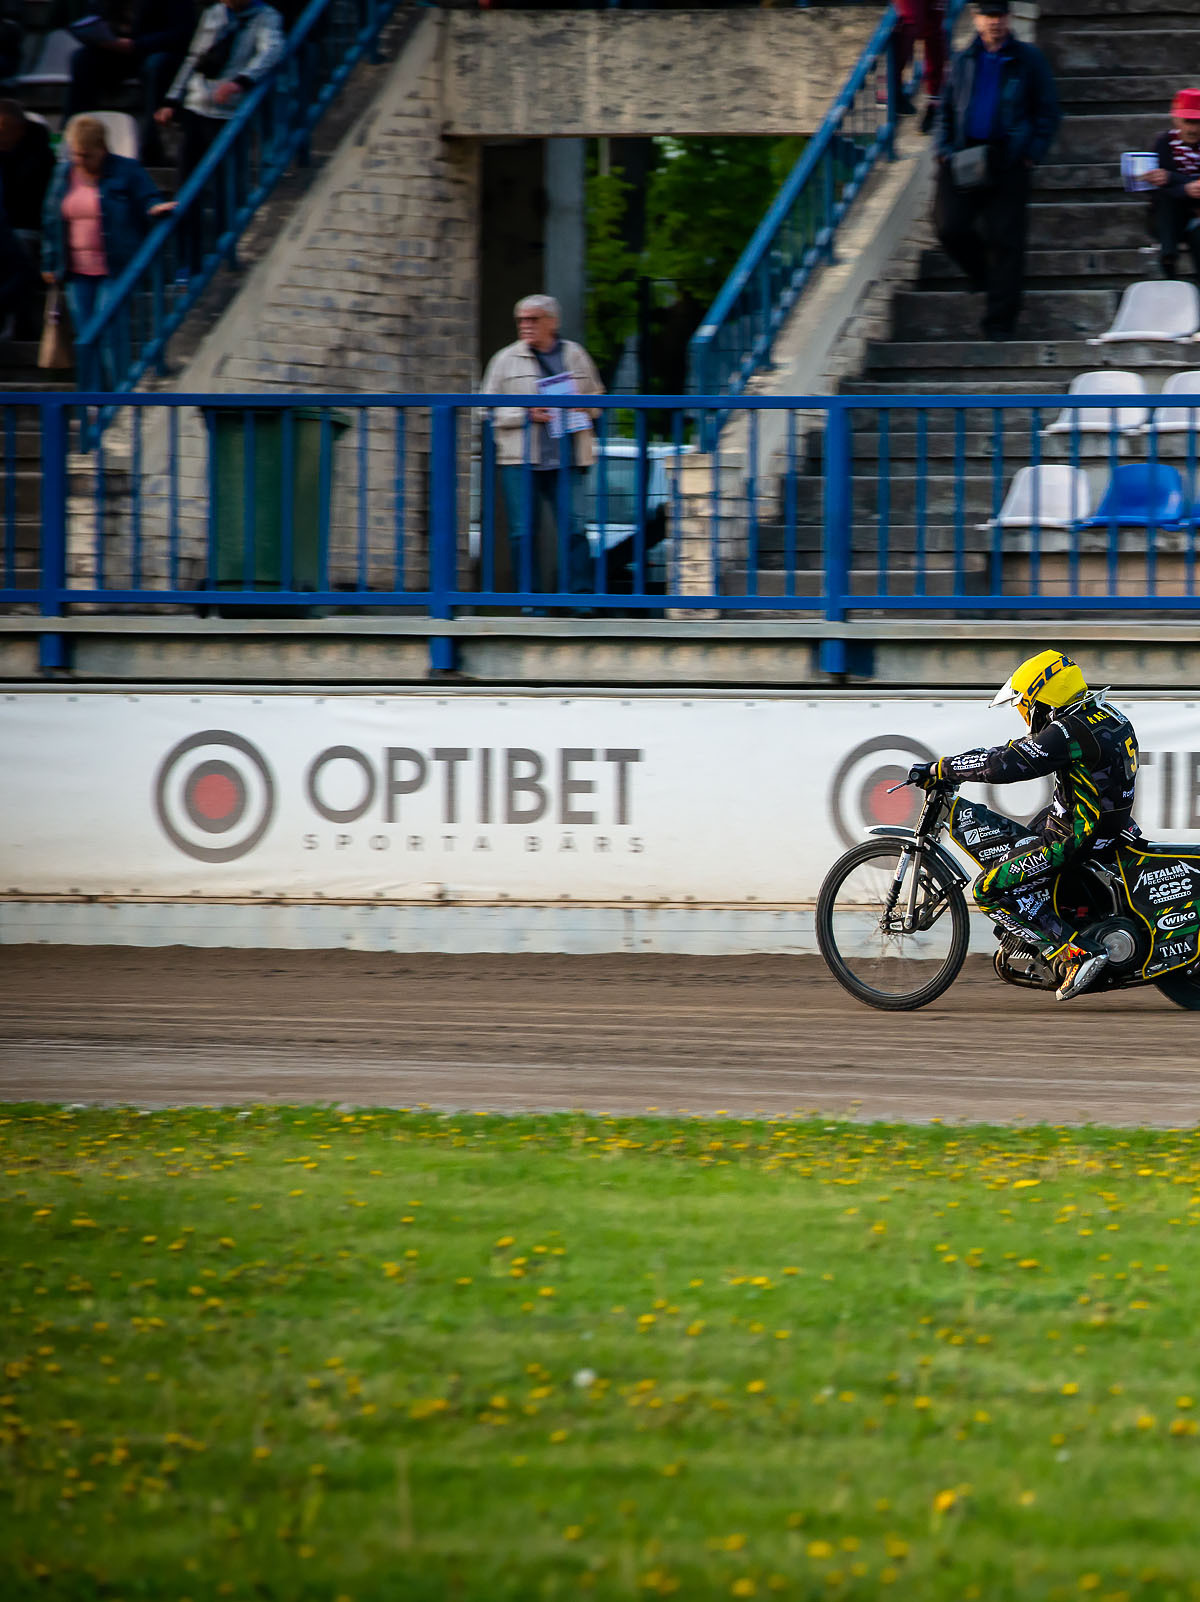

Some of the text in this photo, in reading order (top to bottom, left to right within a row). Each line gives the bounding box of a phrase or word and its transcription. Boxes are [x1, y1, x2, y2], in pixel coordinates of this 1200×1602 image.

[304, 745, 644, 825] OPTIBET
[301, 833, 492, 852] SPORTA
[523, 832, 645, 853] BĀRS
[1018, 852, 1044, 871] KIM
[1164, 911, 1196, 926] WIKO
[1159, 941, 1192, 958] TATA
